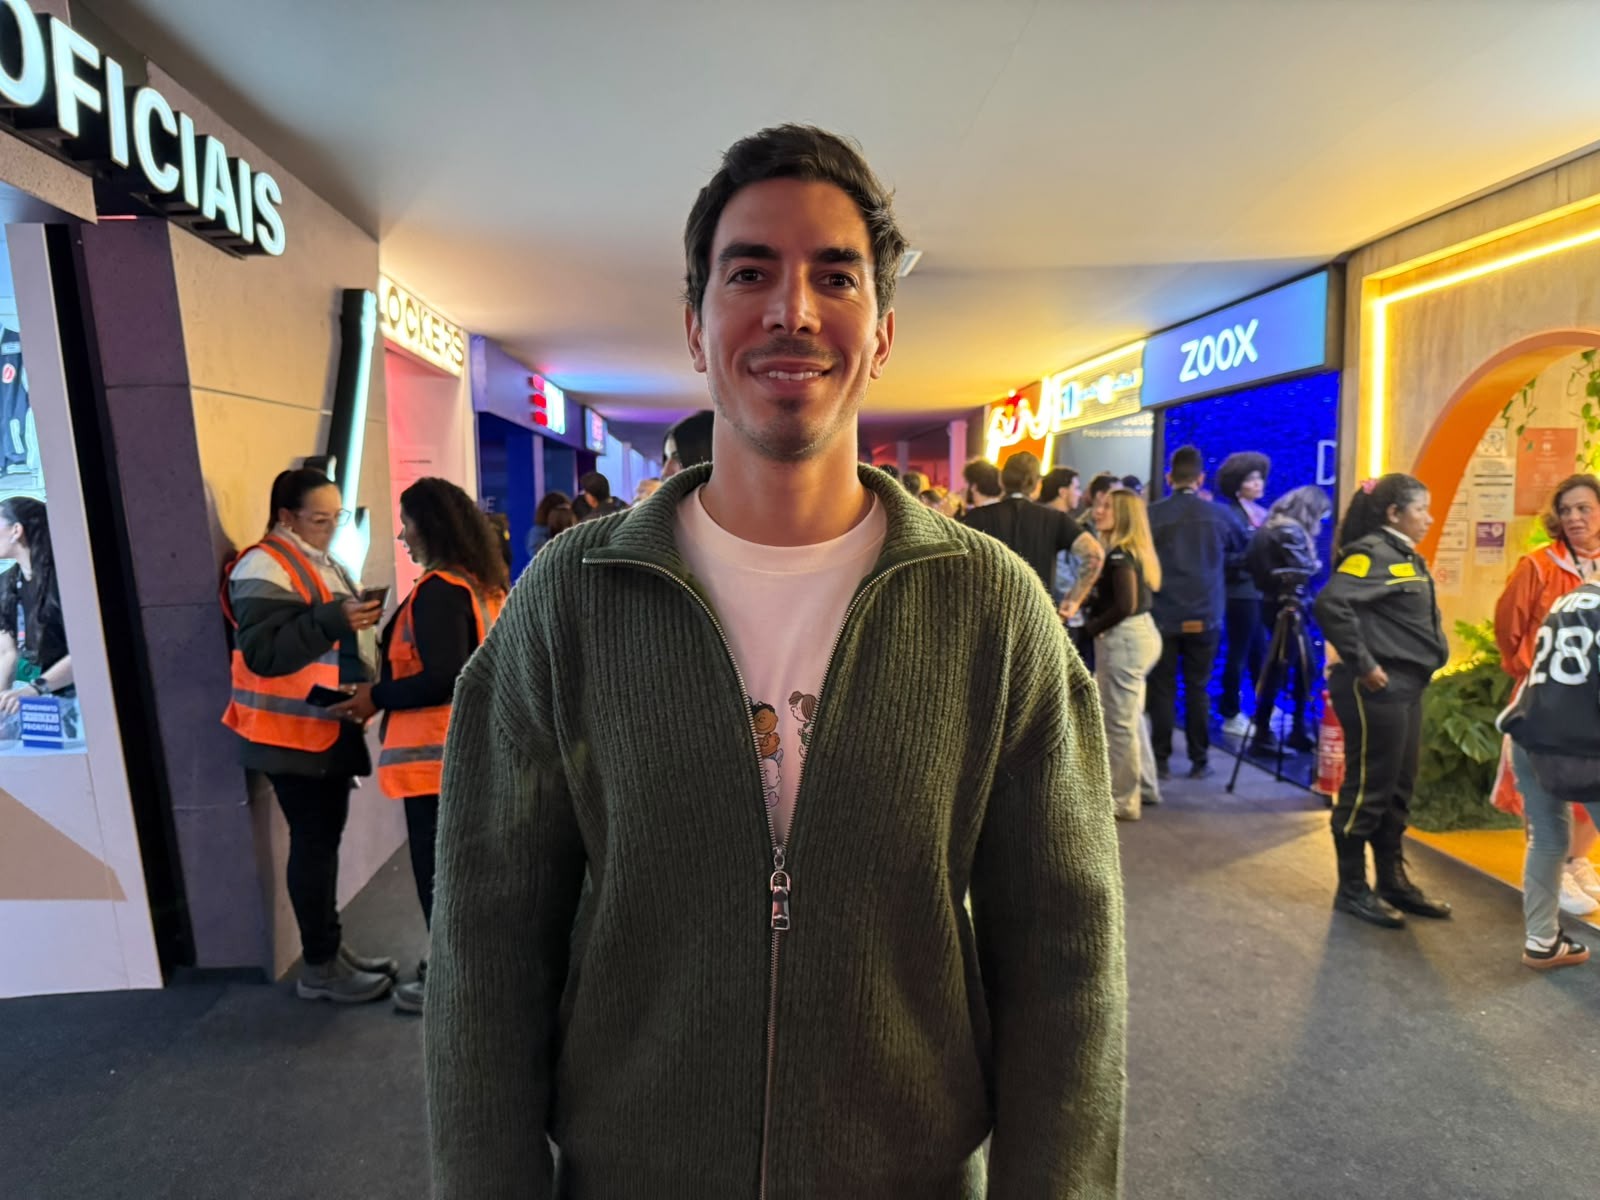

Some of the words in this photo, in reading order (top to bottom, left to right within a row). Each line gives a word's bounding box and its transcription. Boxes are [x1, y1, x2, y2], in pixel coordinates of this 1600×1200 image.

[0, 0, 287, 257] OFICIAIS
[1179, 318, 1259, 383] ZOOX
[1528, 625, 1600, 688] 28
